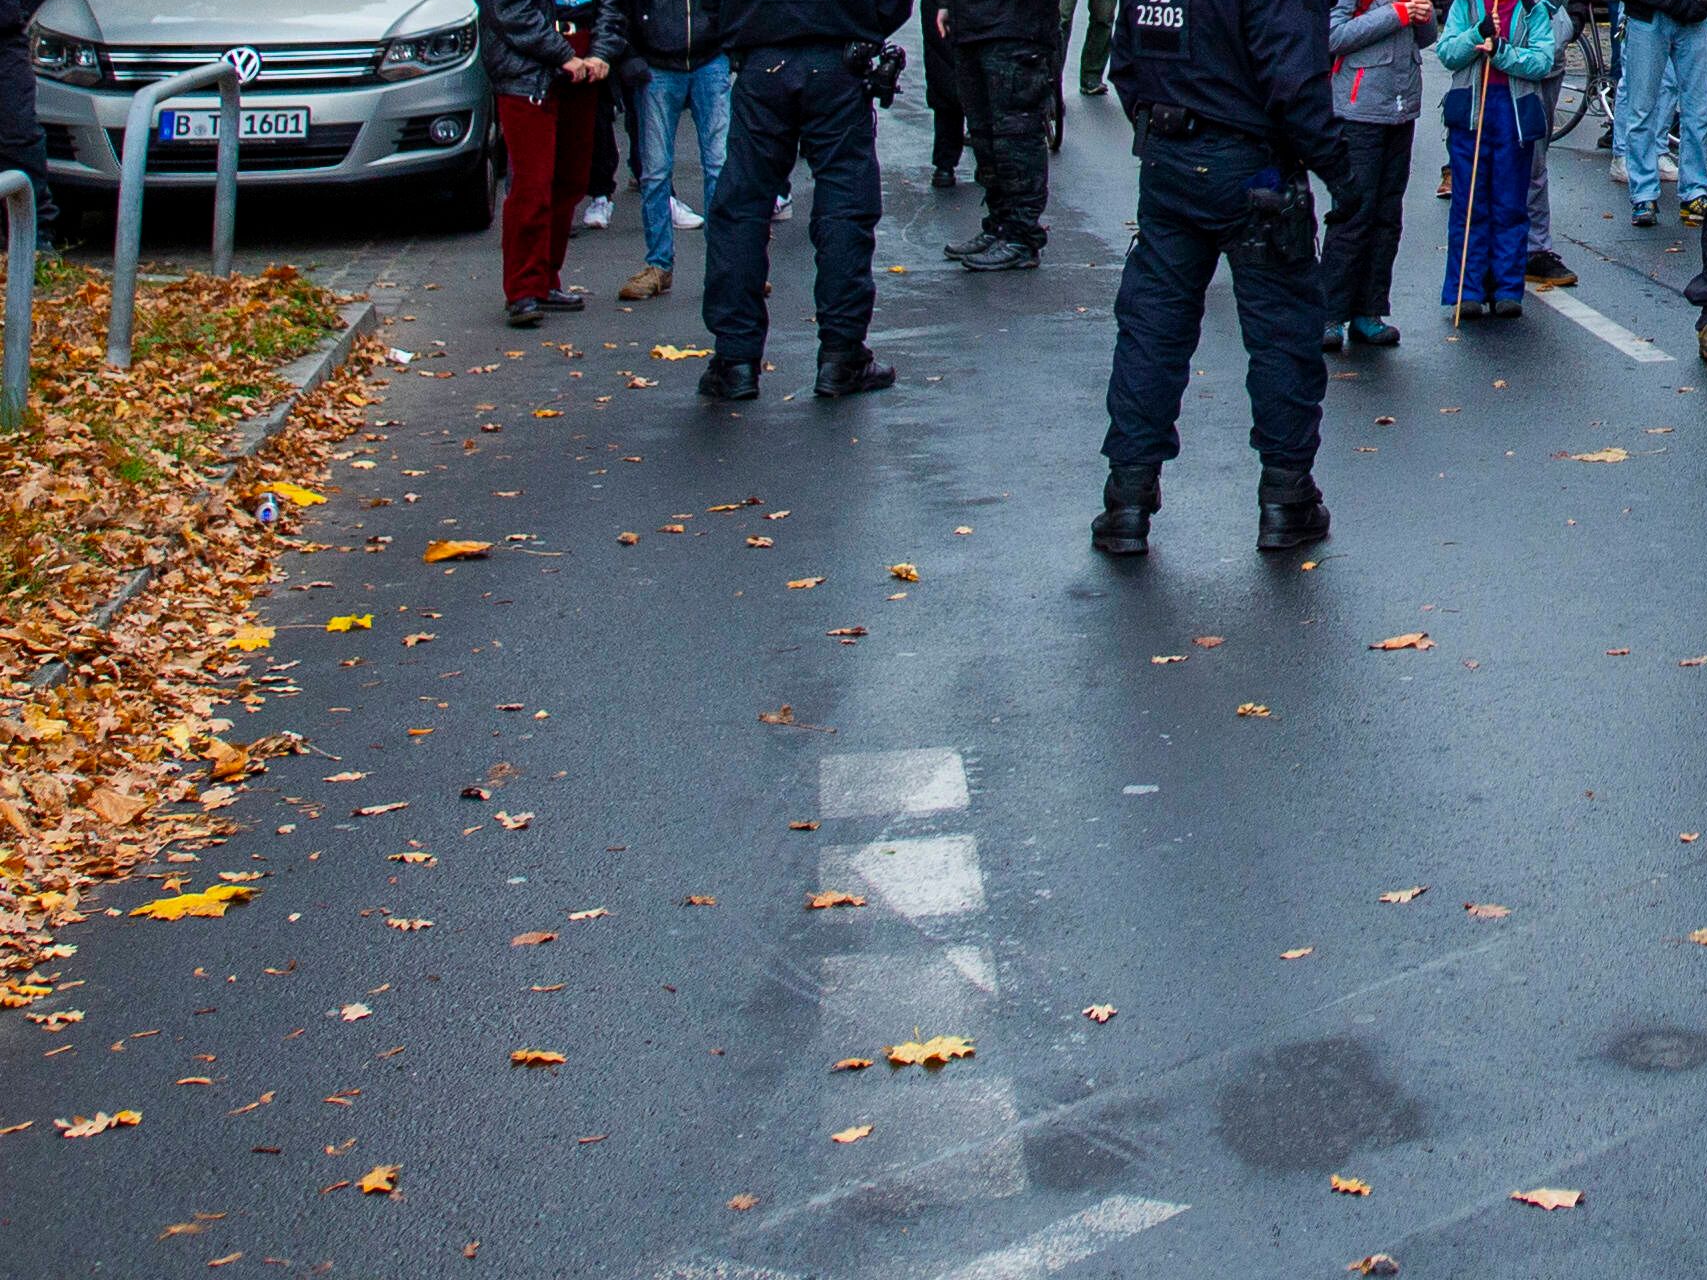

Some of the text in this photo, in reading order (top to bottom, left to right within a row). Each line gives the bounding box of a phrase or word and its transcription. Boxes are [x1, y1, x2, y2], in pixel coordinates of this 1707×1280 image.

[1136, 5, 1184, 28] 22303
[176, 115, 191, 136] B
[244, 113, 303, 135] 1601
